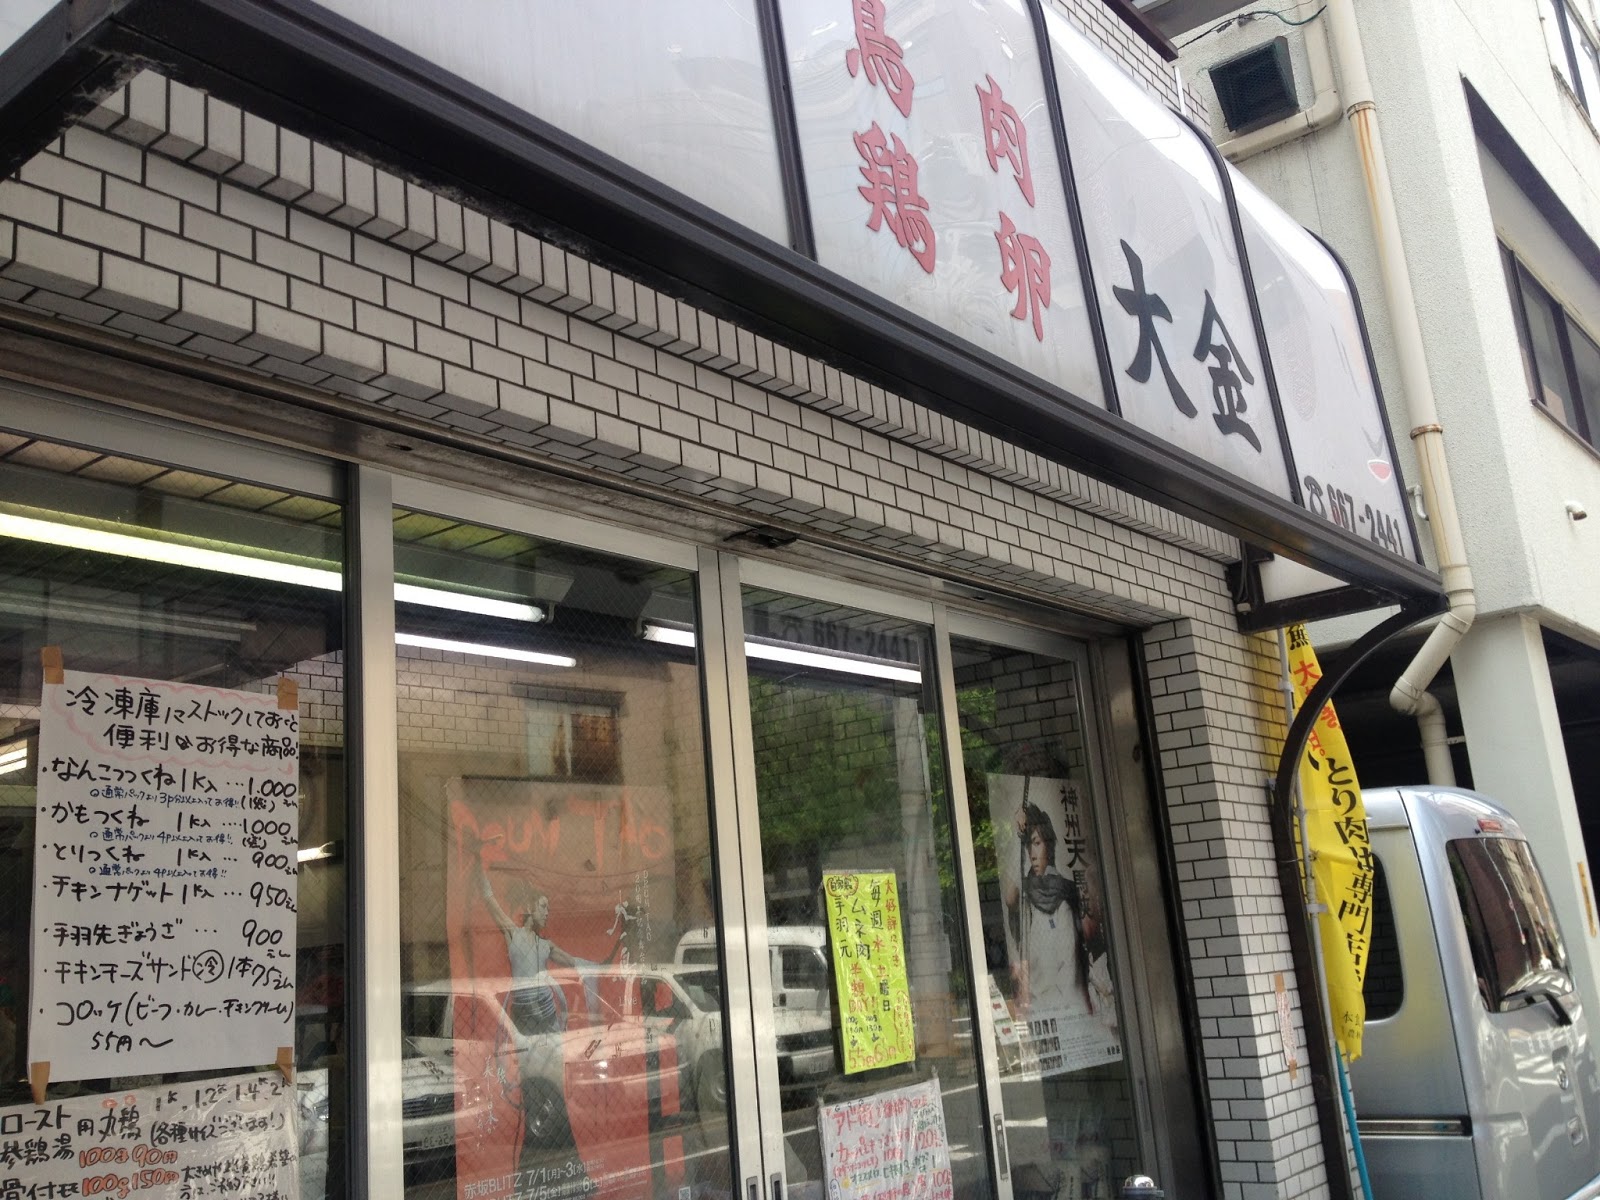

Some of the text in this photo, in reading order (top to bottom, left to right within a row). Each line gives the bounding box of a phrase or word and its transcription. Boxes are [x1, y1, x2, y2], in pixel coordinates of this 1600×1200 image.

[1113, 238, 1261, 453] 大金
[1326, 483, 1406, 558] 667-2441
[52, 875, 174, 903] チキンナゲット
[54, 918, 183, 946] 手羽先ぎょうざ
[1, 1104, 72, 1135] ロースト
